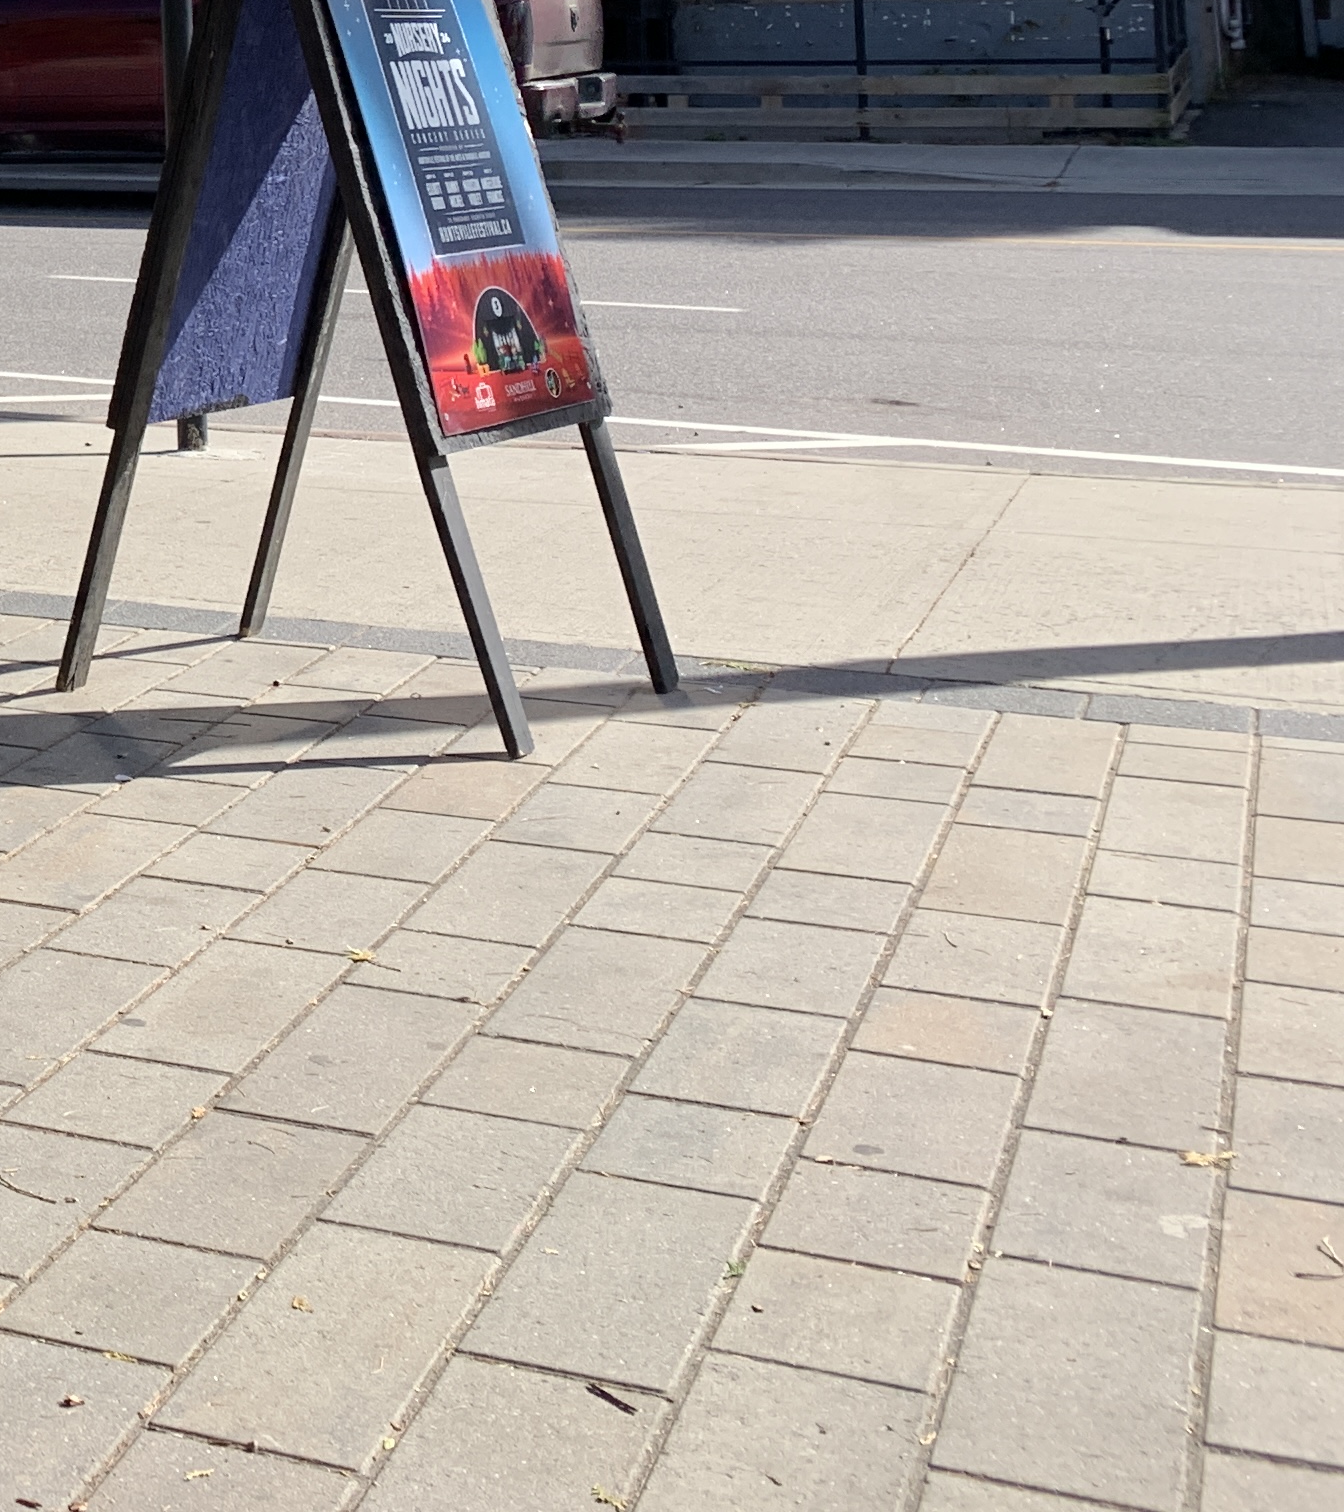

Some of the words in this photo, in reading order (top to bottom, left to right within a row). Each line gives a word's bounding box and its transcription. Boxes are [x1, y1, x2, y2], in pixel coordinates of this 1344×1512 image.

[390, 22, 444, 57] NURSERY
[389, 58, 480, 130] NIGHTS
[410, 131, 449, 144] CONCERT
[453, 128, 486, 141] SERIES
